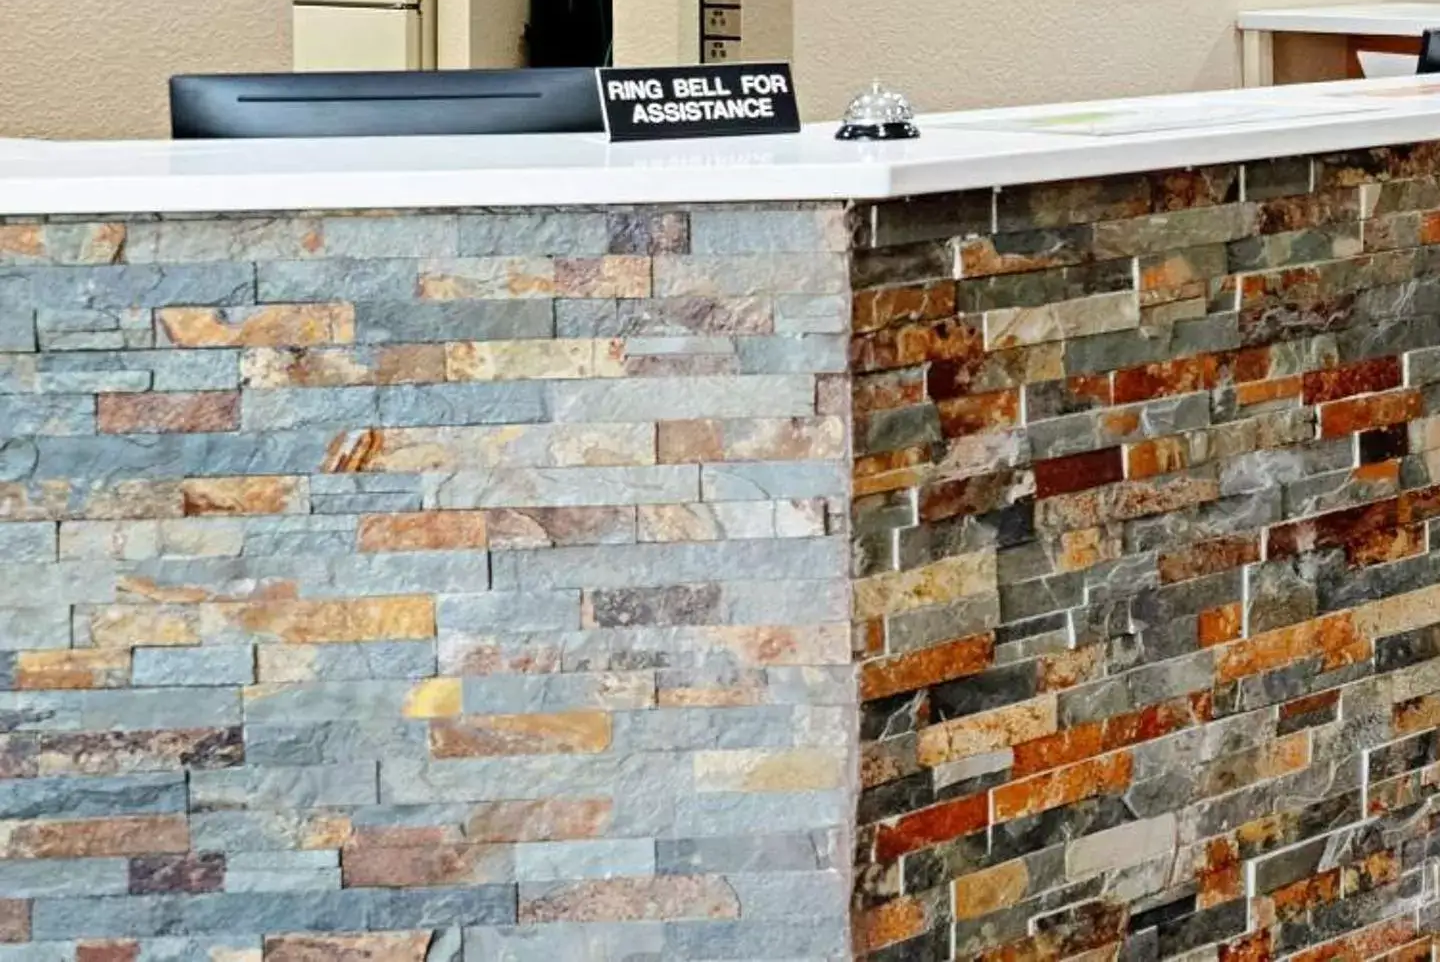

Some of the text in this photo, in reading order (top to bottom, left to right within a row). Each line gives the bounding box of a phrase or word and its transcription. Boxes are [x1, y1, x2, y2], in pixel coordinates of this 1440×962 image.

[607, 74, 788, 101] RING BELL FOR
[632, 97, 775, 124] ASSISTANCE
